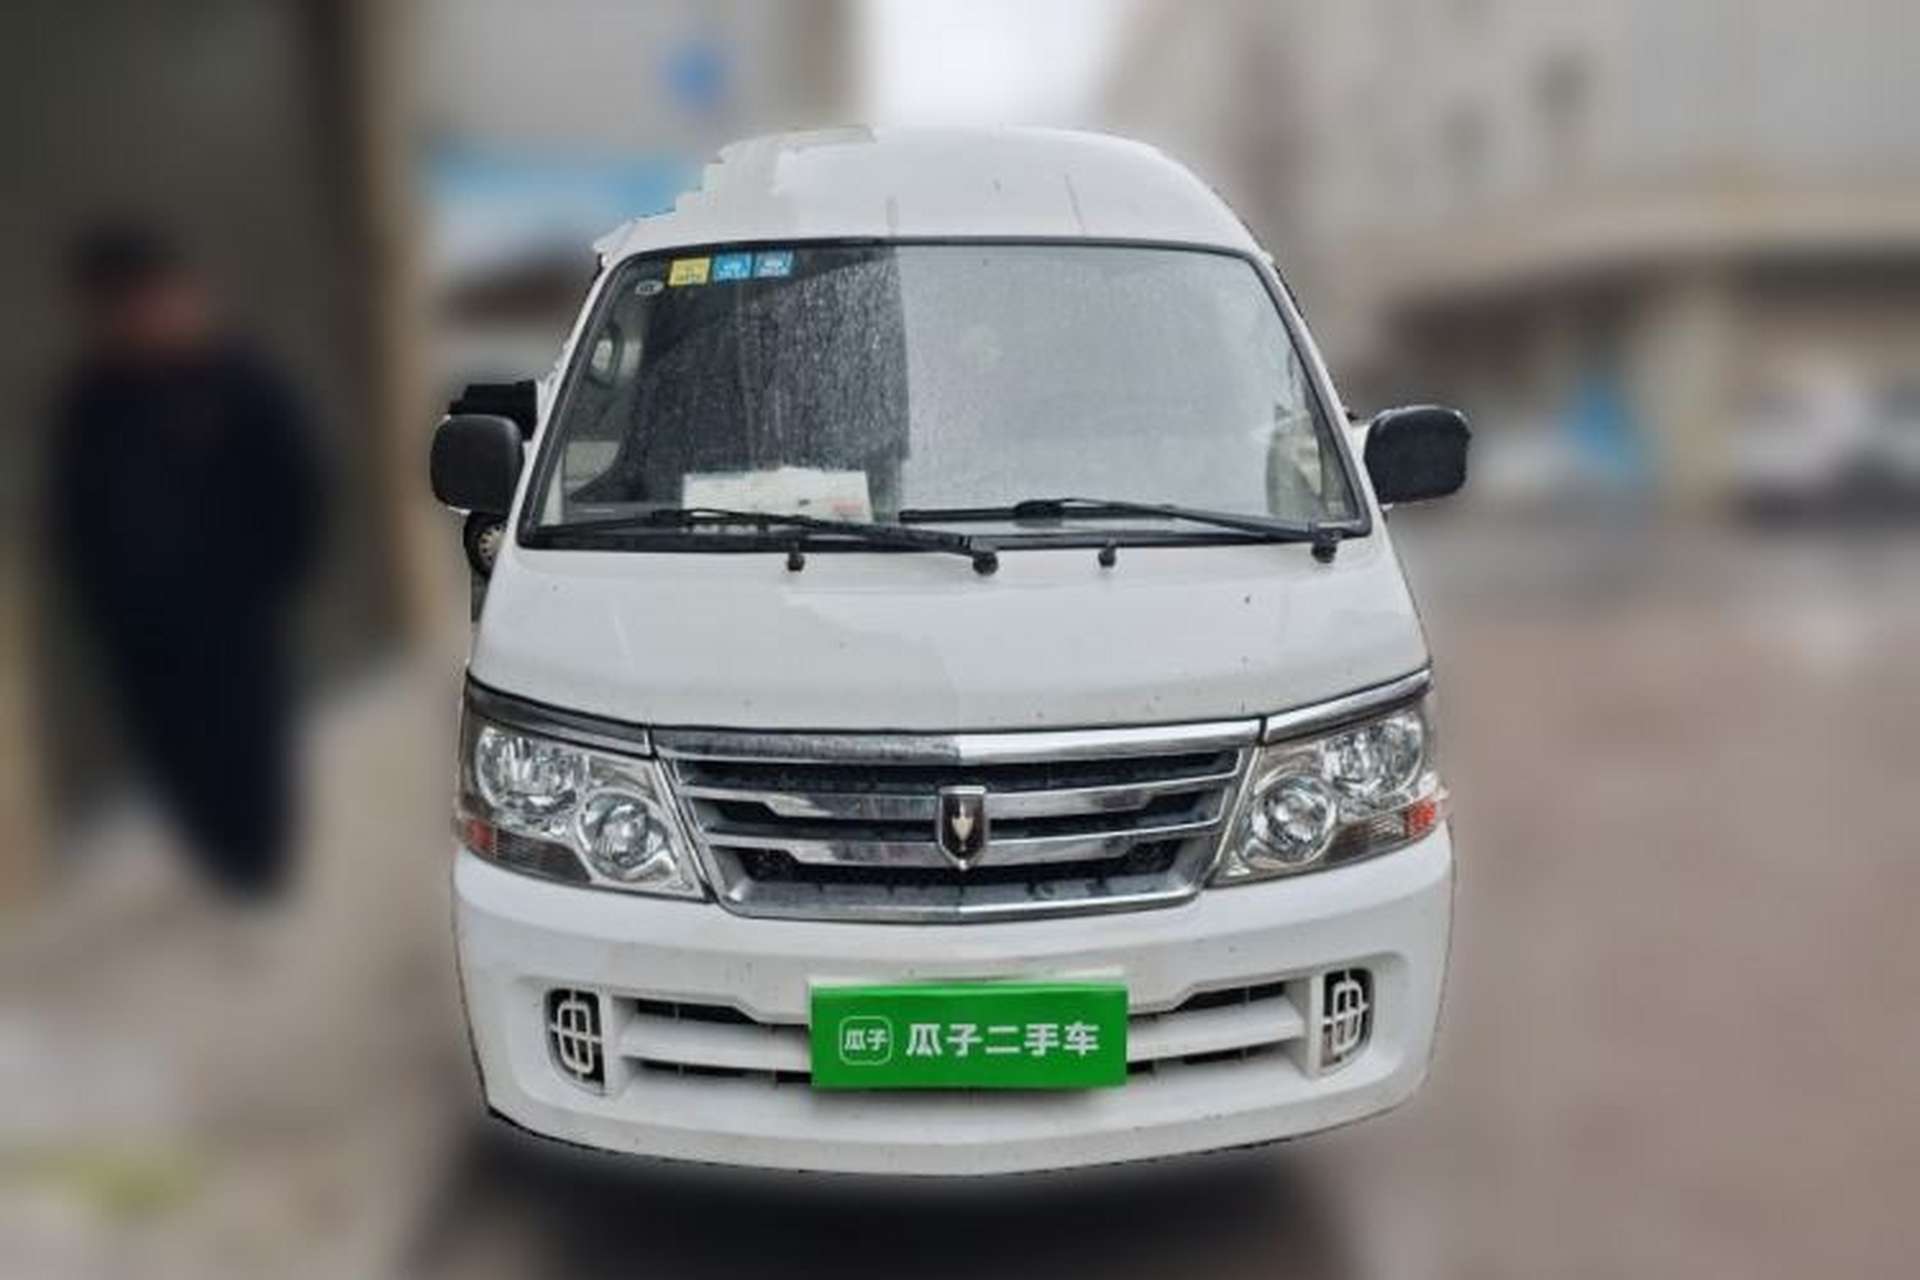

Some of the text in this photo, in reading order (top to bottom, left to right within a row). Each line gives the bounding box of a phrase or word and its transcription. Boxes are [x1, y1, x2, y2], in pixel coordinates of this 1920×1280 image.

[844, 1029, 888, 1051] 瓜子
[906, 1021, 1100, 1056] 瓜子二手车
